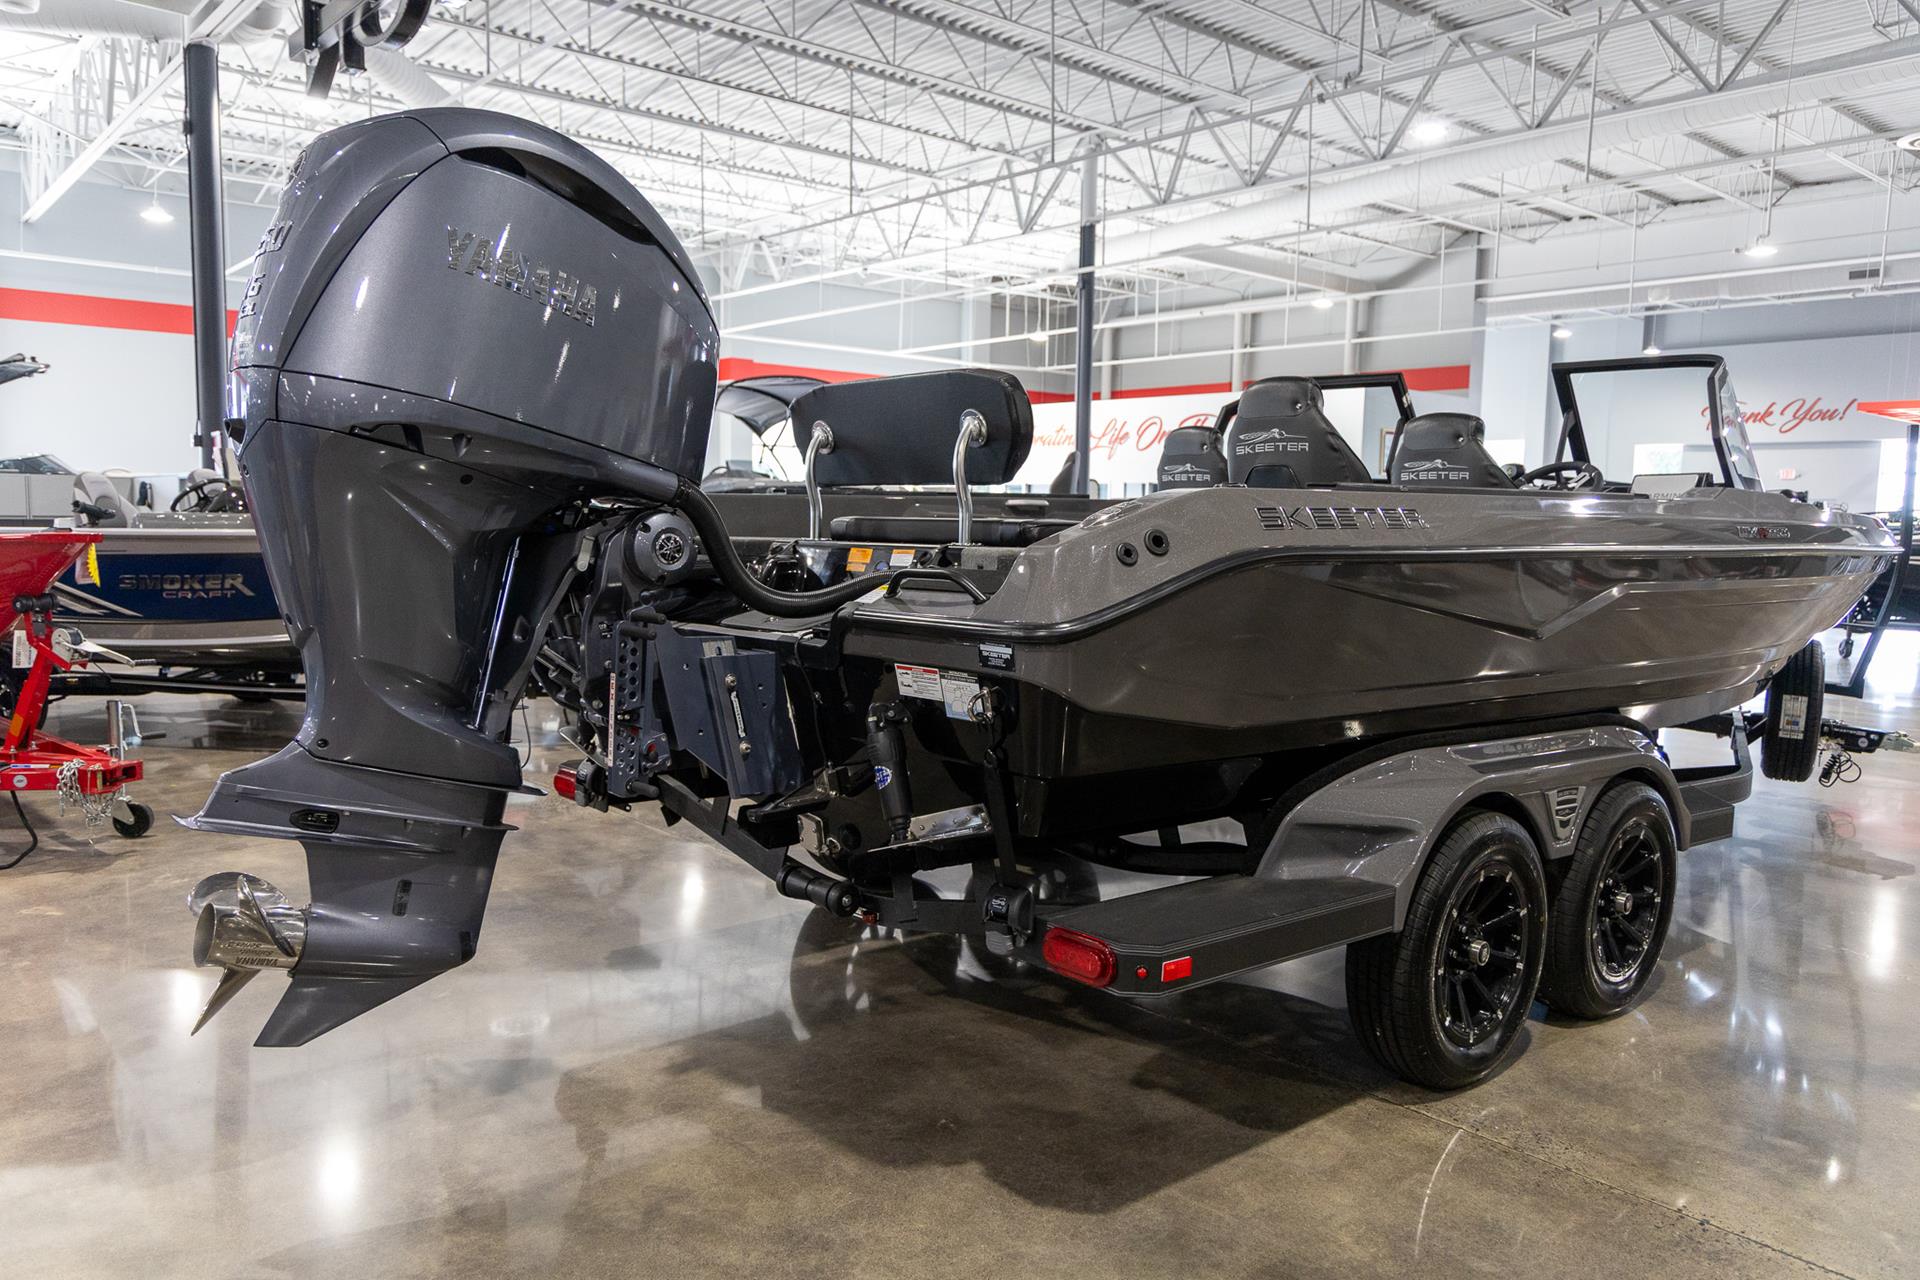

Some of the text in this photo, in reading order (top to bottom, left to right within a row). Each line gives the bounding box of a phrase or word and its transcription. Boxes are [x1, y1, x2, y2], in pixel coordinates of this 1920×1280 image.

[447, 225, 596, 327] YAMAHA
[1779, 397, 1858, 433] You!
[1090, 417, 1129, 460] Life
[1235, 442, 1309, 456] SKEETER
[1161, 473, 1211, 482] SKEETER
[1400, 471, 1470, 481] SKEETER
[1254, 505, 1429, 530] SKEETER
[119, 573, 255, 596] SMOKER
[163, 590, 235, 599] CRAFT
